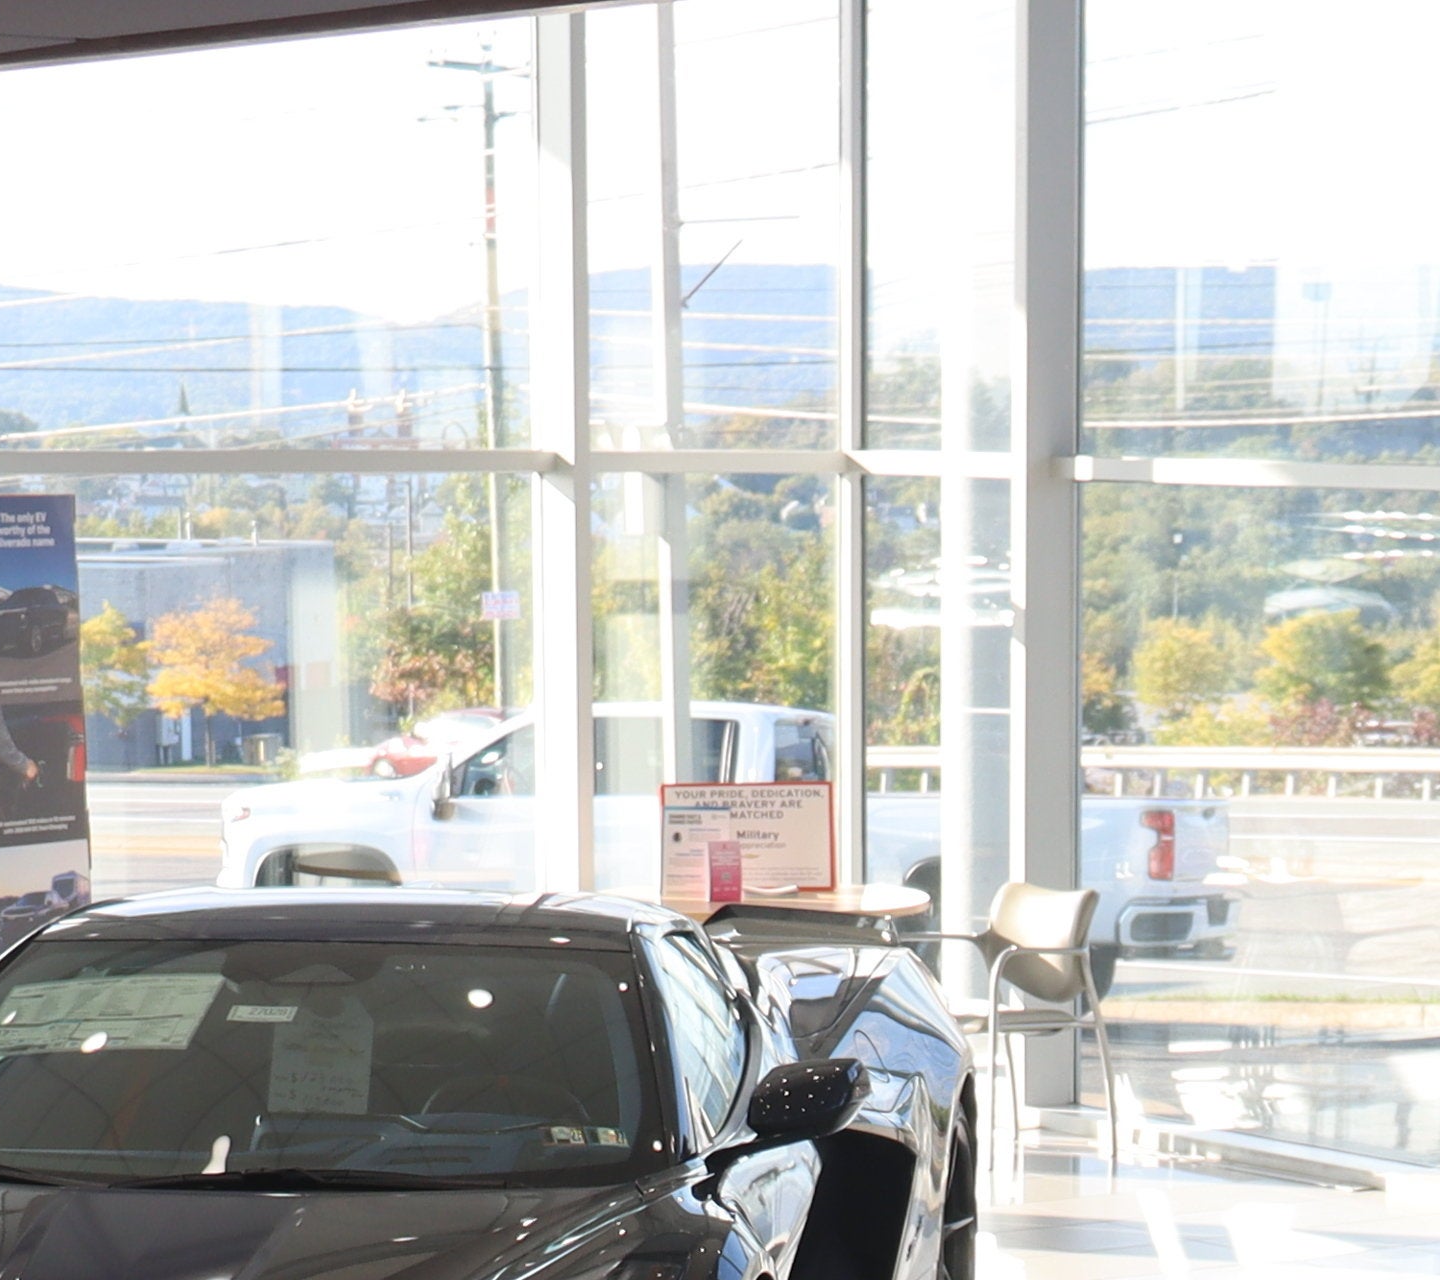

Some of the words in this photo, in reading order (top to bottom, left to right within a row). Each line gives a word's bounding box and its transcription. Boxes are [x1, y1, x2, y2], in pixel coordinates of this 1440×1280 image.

[710, 790, 748, 799] PRIDE,
[752, 789, 824, 798] DEDICATION,
[780, 800, 802, 808] ARE
[730, 811, 784, 819] MATCHED
[737, 830, 779, 841] Military
